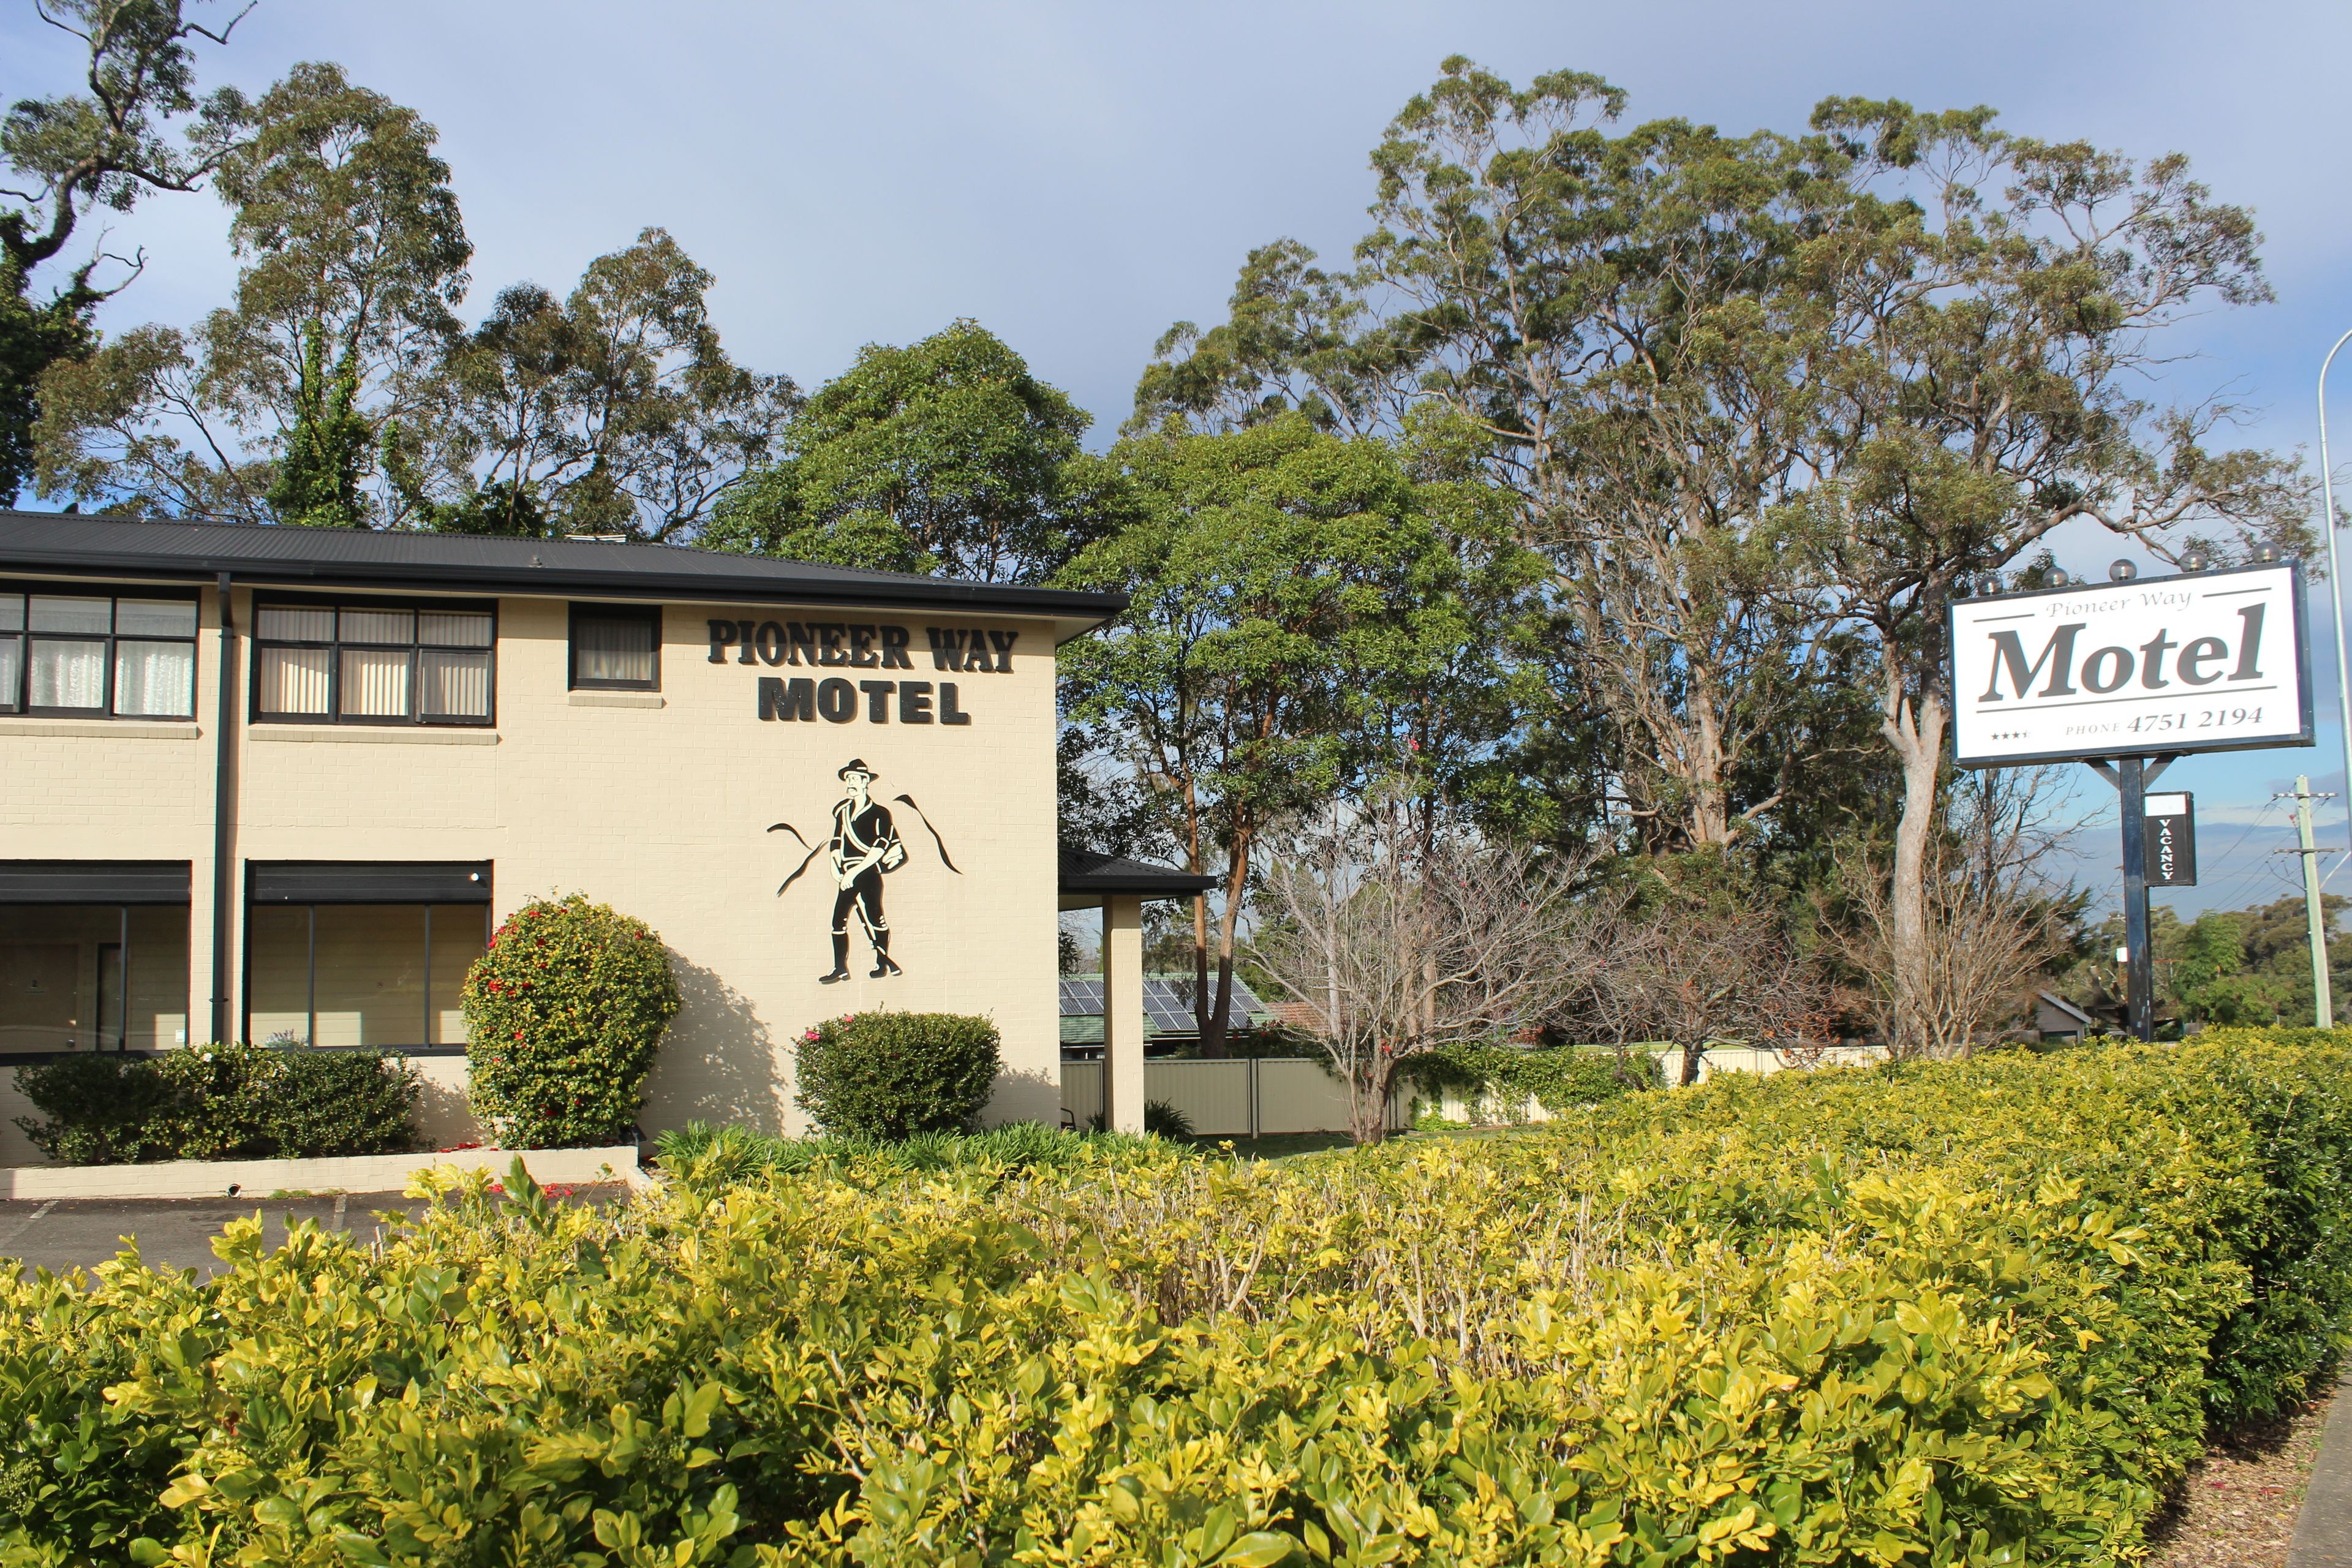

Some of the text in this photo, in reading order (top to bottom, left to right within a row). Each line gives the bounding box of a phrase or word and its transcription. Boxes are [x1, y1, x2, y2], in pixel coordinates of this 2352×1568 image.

[2046, 591, 2193, 617] Pioneer Way
[707, 619, 1019, 673] PIONEER WAY
[1978, 602, 2266, 703] Motel
[758, 676, 971, 725] MOTEL
[2065, 706, 2263, 736] PHONE 4751 2194
[2158, 818, 2174, 880] VACANCY
